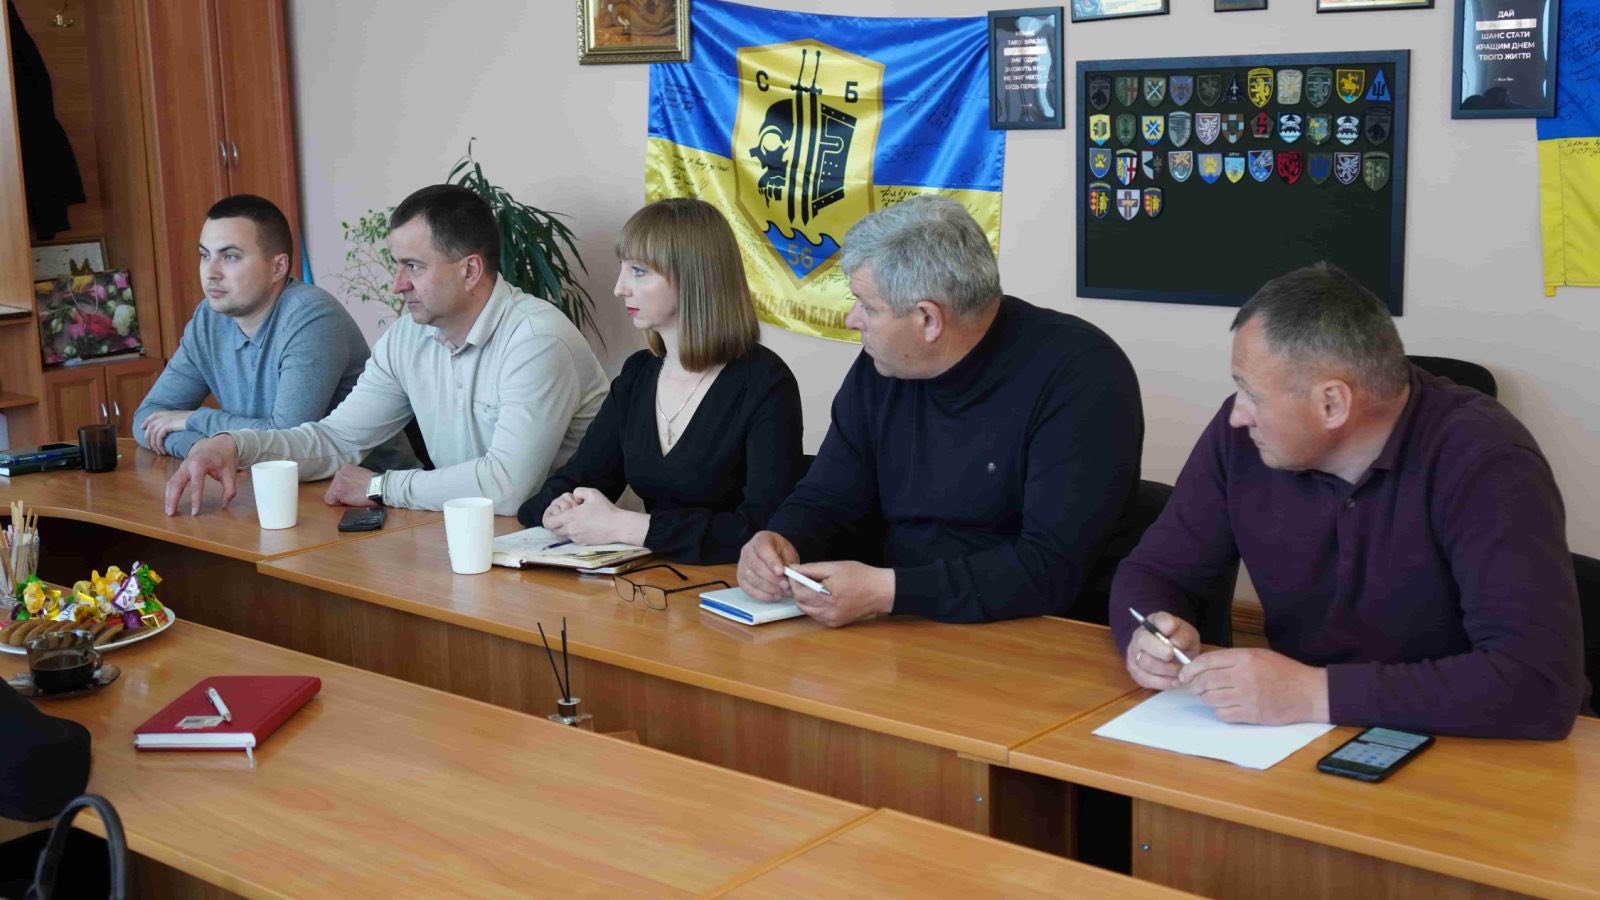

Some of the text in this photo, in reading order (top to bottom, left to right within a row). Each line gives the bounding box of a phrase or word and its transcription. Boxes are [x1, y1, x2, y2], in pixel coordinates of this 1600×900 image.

[1497, 9, 1515, 18] ДАЙ
[756, 70, 859, 103] С Б
[788, 243, 813, 268] 56
